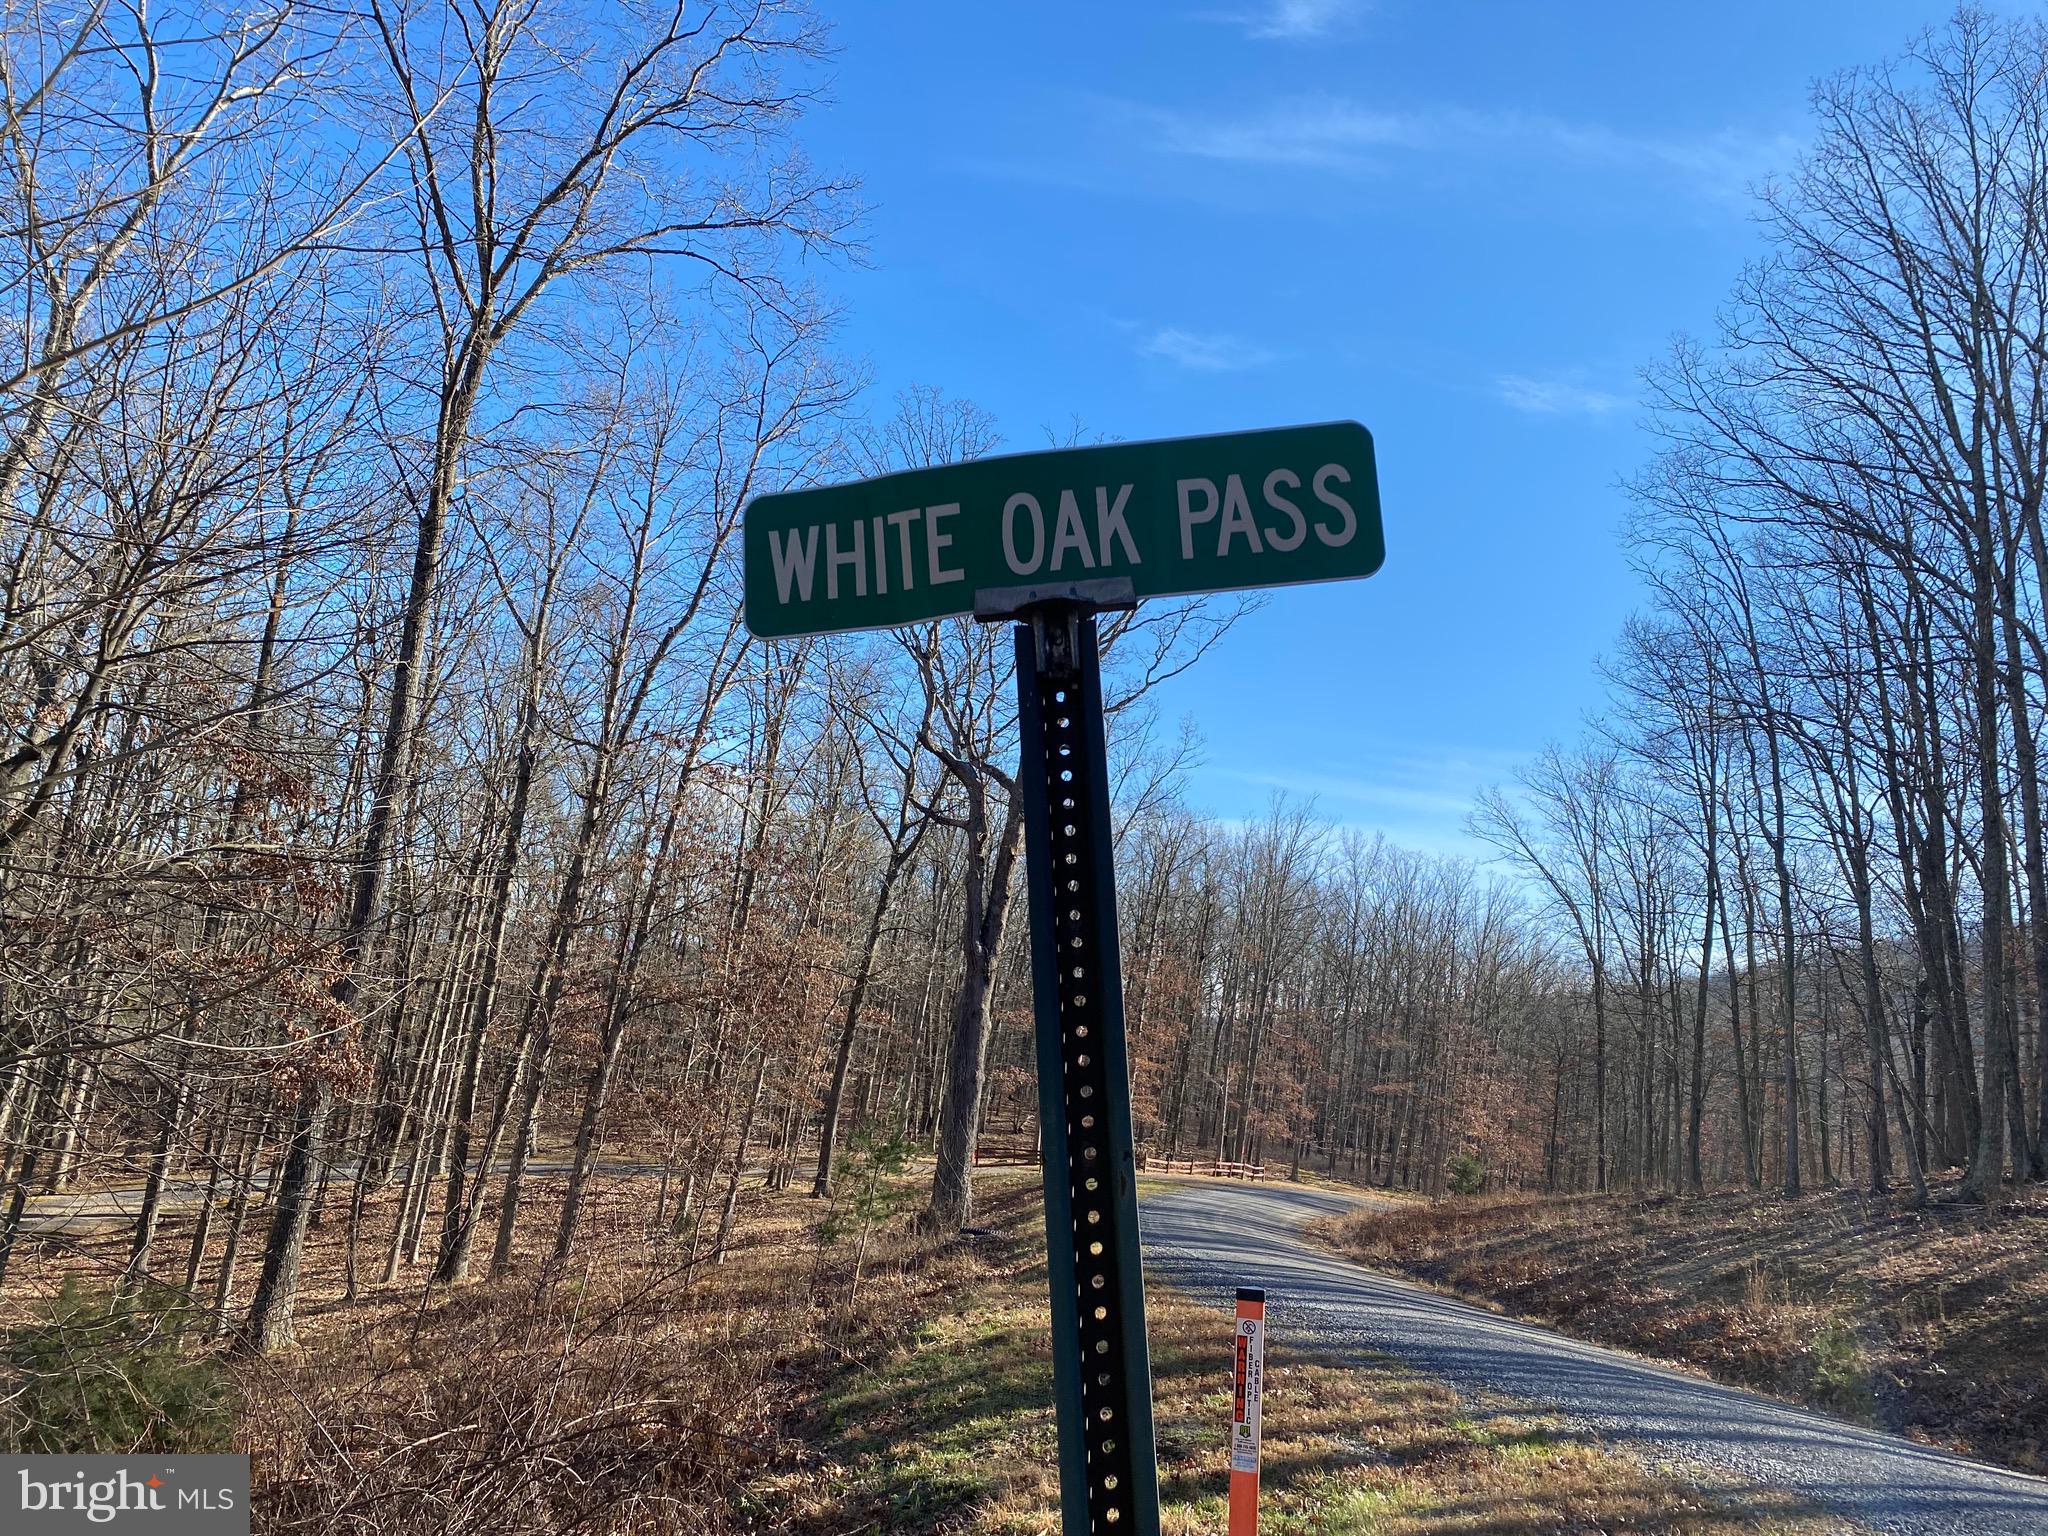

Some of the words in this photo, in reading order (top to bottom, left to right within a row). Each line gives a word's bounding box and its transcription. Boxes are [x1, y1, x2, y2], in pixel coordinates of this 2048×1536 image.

[768, 502, 965, 604] WHITE
[1001, 483, 1142, 576] OAK
[1177, 463, 1358, 560] PASS
[1236, 1336, 1247, 1421] WARNING
